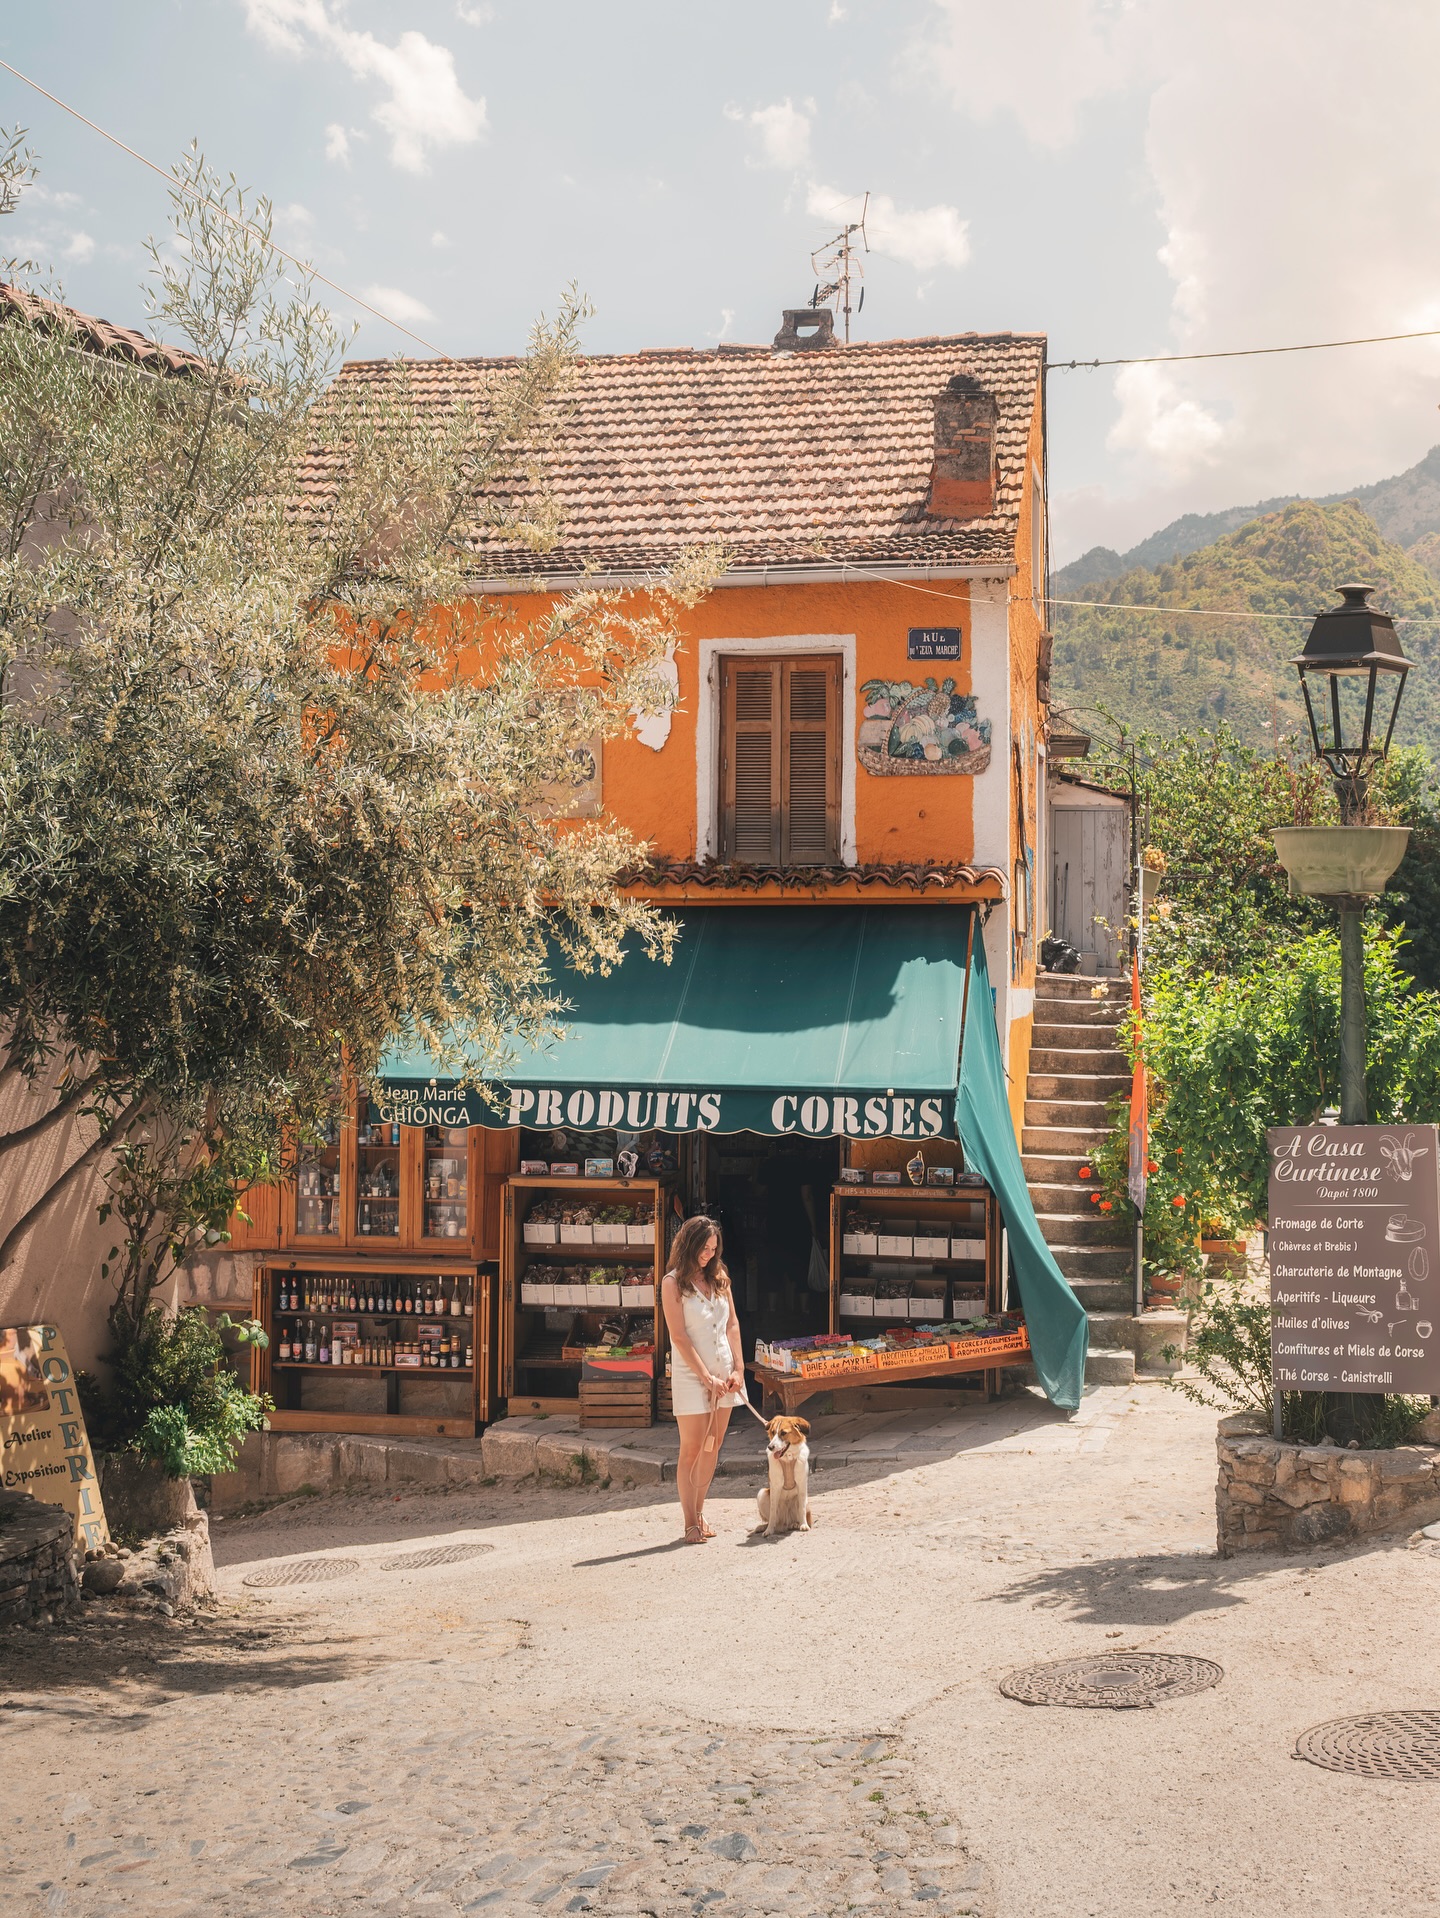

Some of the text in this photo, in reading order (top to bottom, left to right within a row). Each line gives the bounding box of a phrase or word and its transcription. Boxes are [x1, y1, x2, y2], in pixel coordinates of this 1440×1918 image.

[423, 1087, 466, 1101] Marie
[508, 1089, 943, 1136] PRODUITS CORSES
[1273, 1133, 1366, 1158] A Casa
[1274, 1159, 1383, 1182] Curtinese
[1316, 1186, 1379, 1200] Dapoi 1800
[1320, 1217, 1333, 1229] de
[1336, 1217, 1365, 1230] Corte
[1278, 1240, 1311, 1251] Chèvres
[1313, 1241, 1322, 1251] et
[1324, 1242, 1352, 1252] Brebis
[1337, 1266, 1350, 1278] de
[1353, 1266, 1403, 1281] Montagne
[1332, 1291, 1376, 1307] Liqueurs
[880, 1350, 918, 1361] AROMATES
[1333, 1345, 1345, 1356] et
[1347, 1344, 1375, 1357] Miels
[1378, 1345, 1391, 1357] de
[1394, 1345, 1425, 1358] Corse
[806, 1362, 828, 1372] BAIES
[842, 1356, 871, 1367] MYRTE
[1300, 1369, 1330, 1382] Corse
[1341, 1370, 1393, 1384] Canistrelli
[4, 1428, 52, 1450] Atelier
[37, 1326, 107, 1550] POTERIE
[5, 1463, 67, 1487] Exposition
